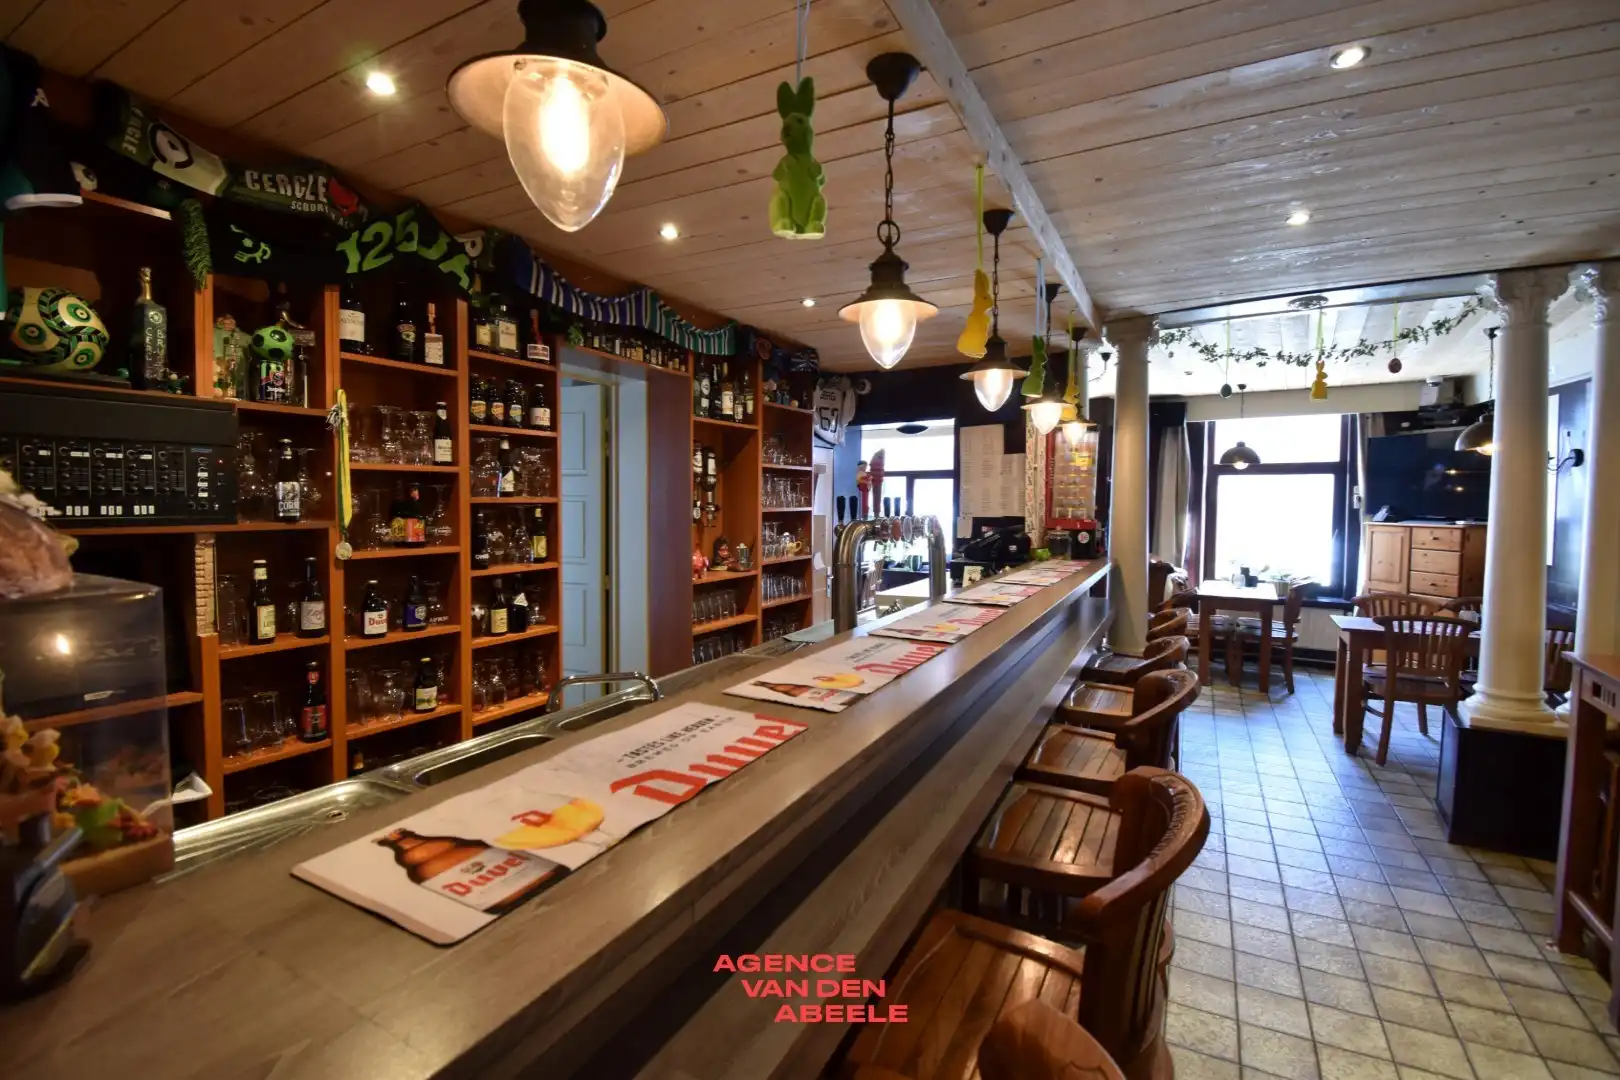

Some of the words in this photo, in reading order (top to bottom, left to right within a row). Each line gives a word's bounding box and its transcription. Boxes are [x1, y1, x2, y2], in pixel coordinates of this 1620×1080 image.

[244, 169, 329, 204] CERCLE
[610, 713, 809, 806] Duvel
[441, 852, 528, 897] Duvel
